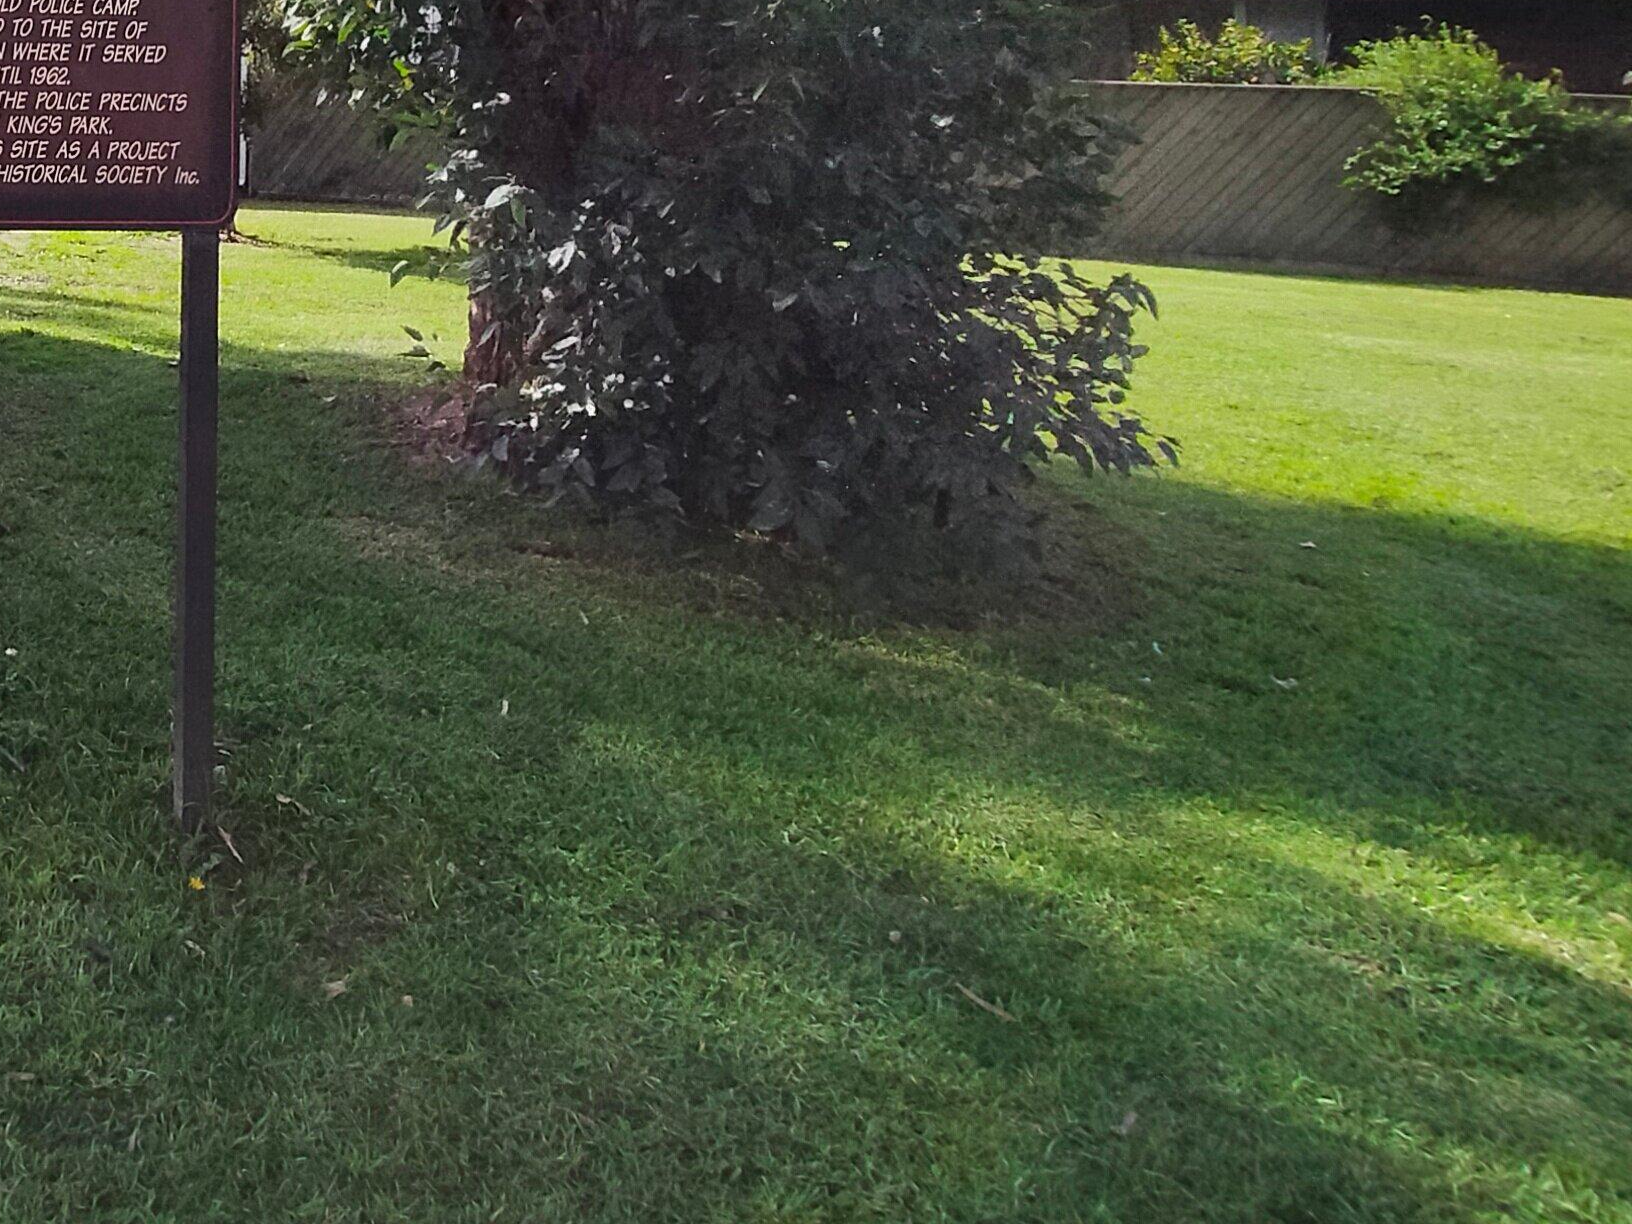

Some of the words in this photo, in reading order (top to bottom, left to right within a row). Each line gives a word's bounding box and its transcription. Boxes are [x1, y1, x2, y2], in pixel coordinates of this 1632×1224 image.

[12, 17, 34, 37] TO
[40, 18, 74, 38] THE
[79, 20, 119, 39] SITE
[124, 20, 149, 40] OF
[12, 42, 72, 62] WHERE
[78, 43, 96, 62] IT
[102, 44, 167, 64] SERVED
[29, 66, 71, 86] 1962.
[34, 90, 93, 111] POLICE
[98, 92, 188, 112] PRECINCTS
[6, 114, 63, 135] KING'S
[68, 115, 113, 135] PARK.
[9, 139, 50, 159] SITE
[55, 140, 81, 160] AS
[87, 140, 100, 159] A
[106, 140, 181, 161] PROJECT
[94, 164, 169, 184] SOCIETY
[174, 166, 200, 185] Inc.
